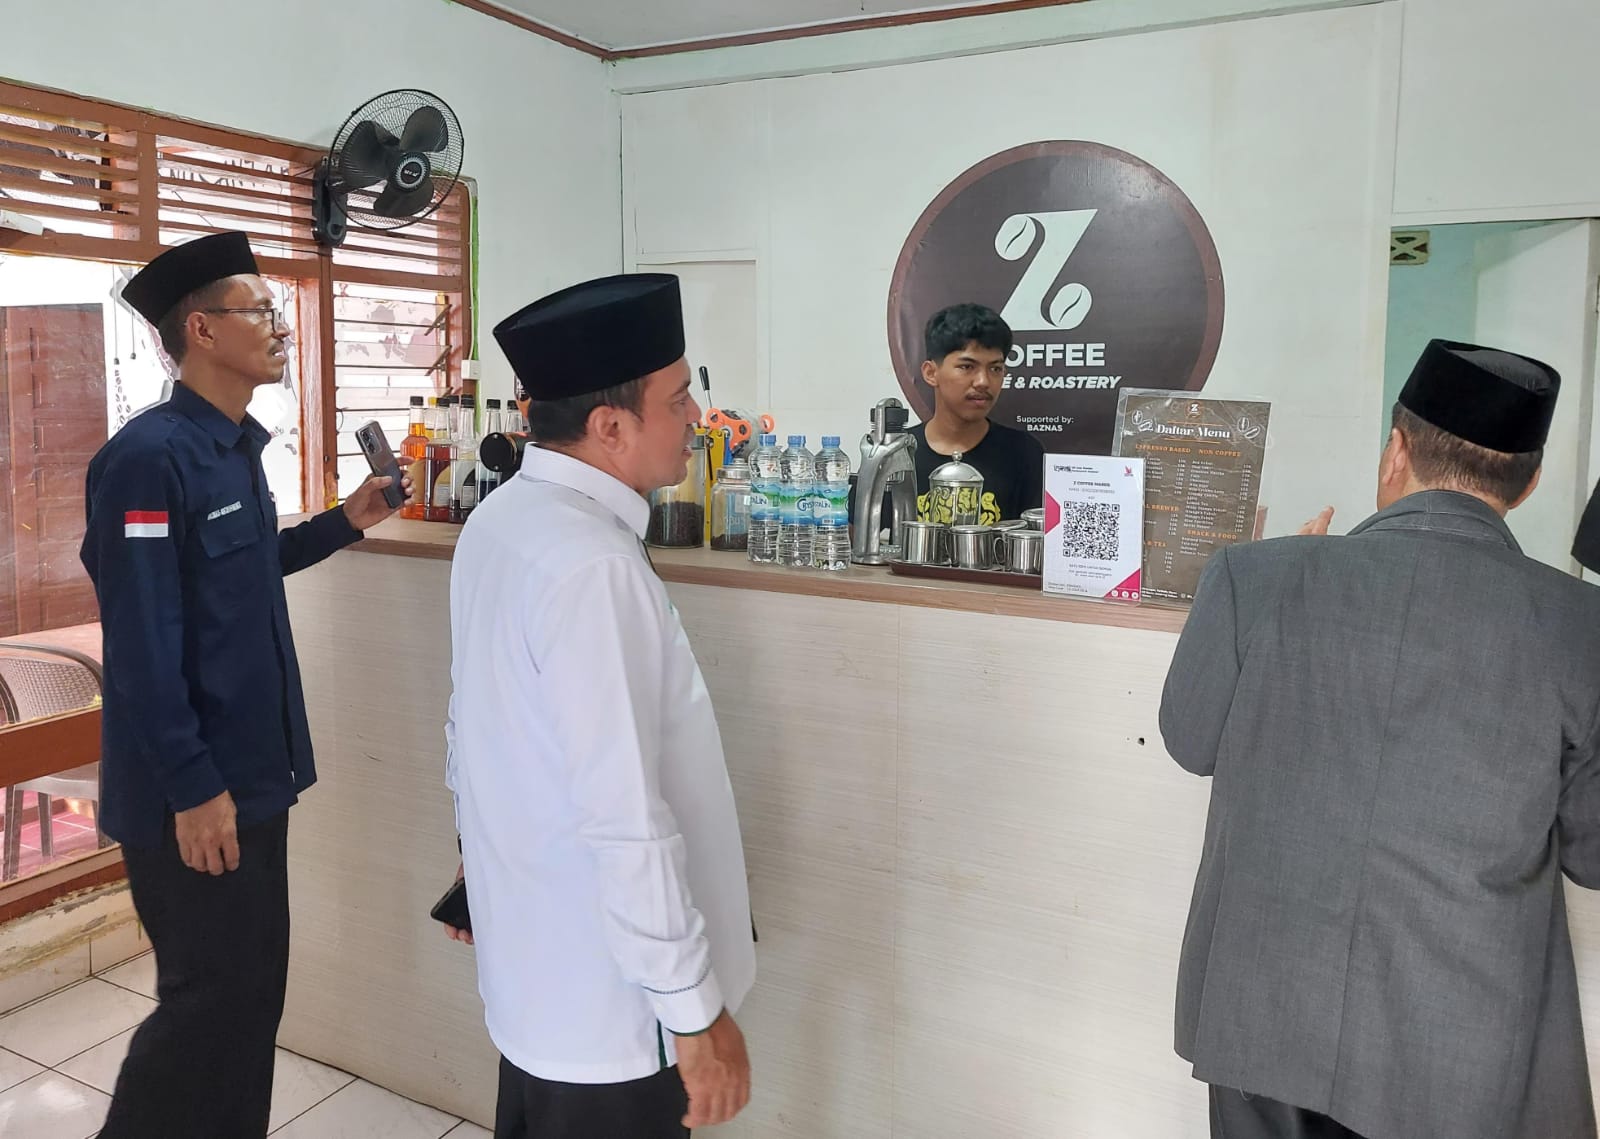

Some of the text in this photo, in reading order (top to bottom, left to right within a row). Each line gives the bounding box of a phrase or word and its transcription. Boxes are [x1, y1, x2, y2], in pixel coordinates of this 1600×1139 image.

[1004, 343, 1106, 367] OFFEE
[1014, 376, 1026, 389] &
[1029, 375, 1122, 389] ROASTERY
[1016, 415, 1060, 423] Supported
[1027, 424, 1063, 432] BAZNAS
[1157, 424, 1231, 438] Daftar Menu
